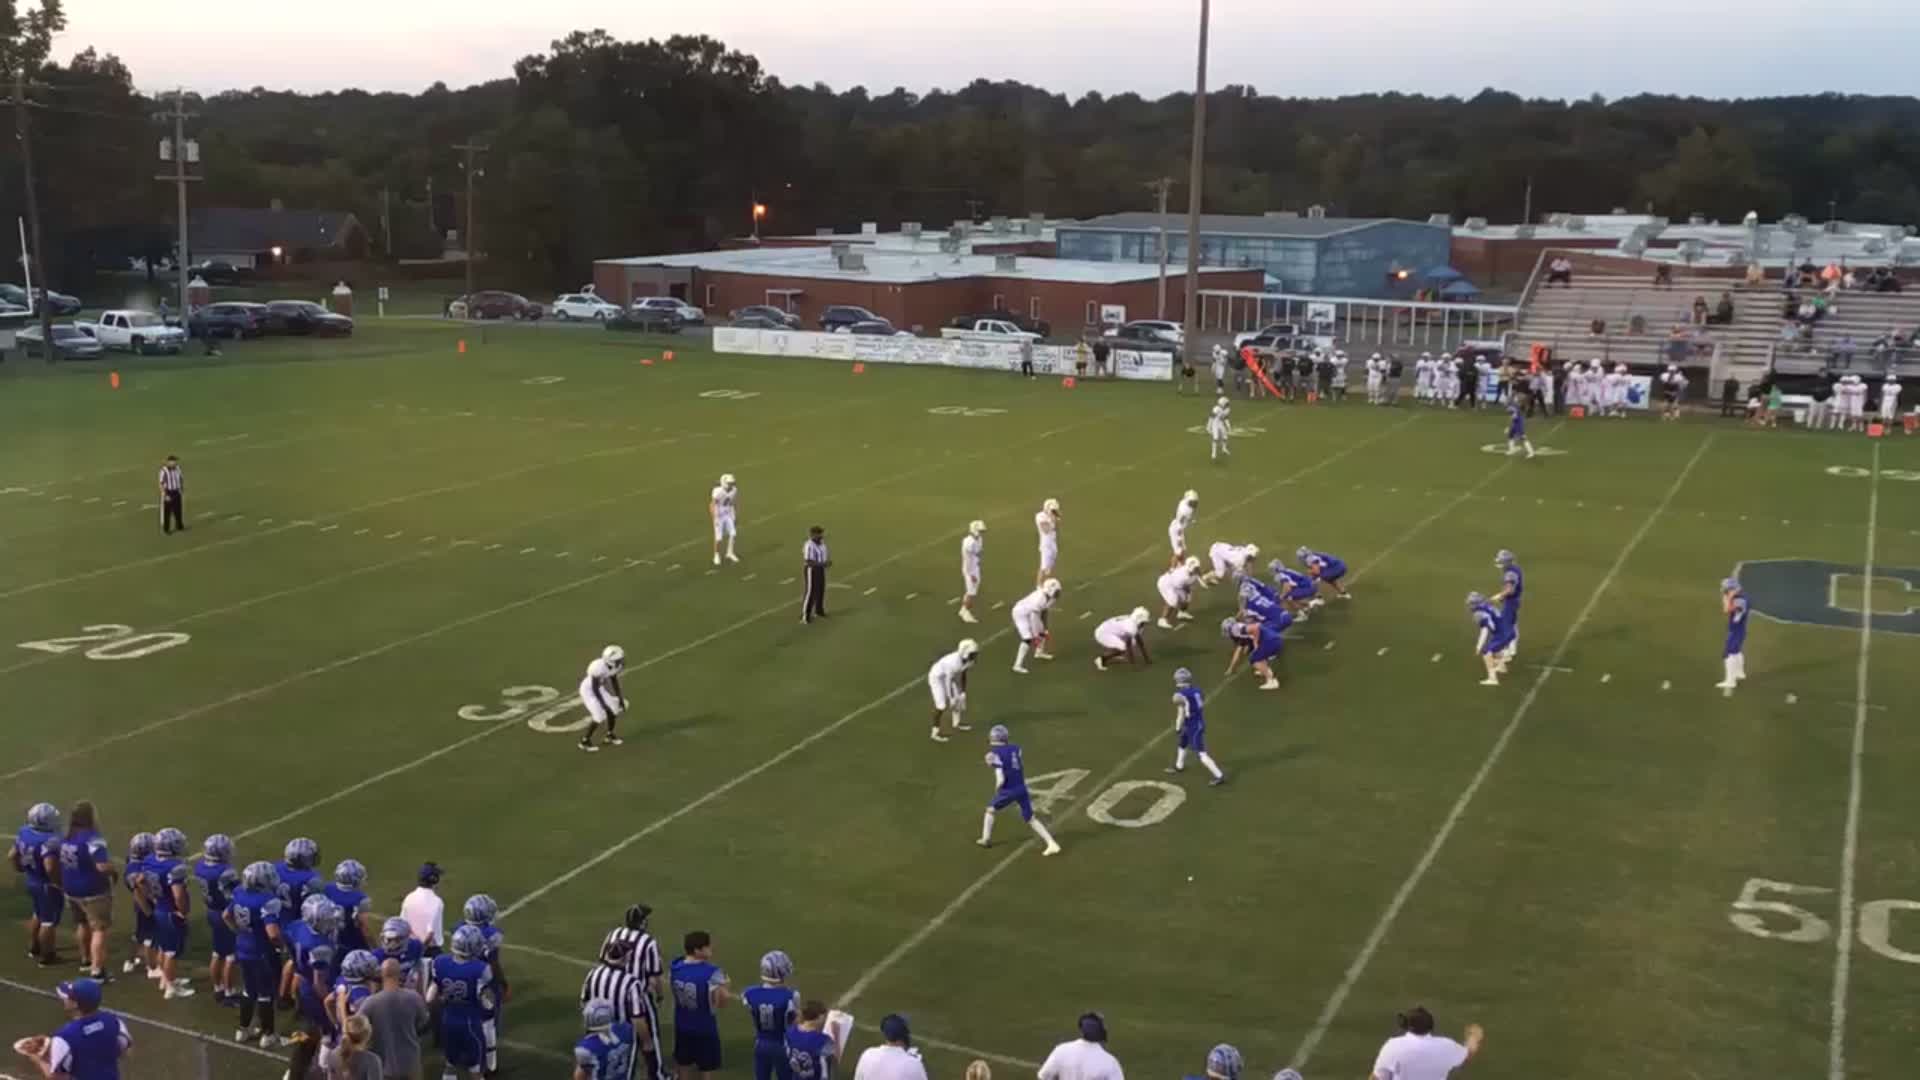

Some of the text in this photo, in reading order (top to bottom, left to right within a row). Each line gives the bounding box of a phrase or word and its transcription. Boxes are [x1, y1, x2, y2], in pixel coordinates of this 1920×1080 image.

[16, 624, 190, 660] 20
[457, 684, 630, 733] 30
[1024, 768, 1187, 828] 40
[1728, 877, 1920, 964] 50
